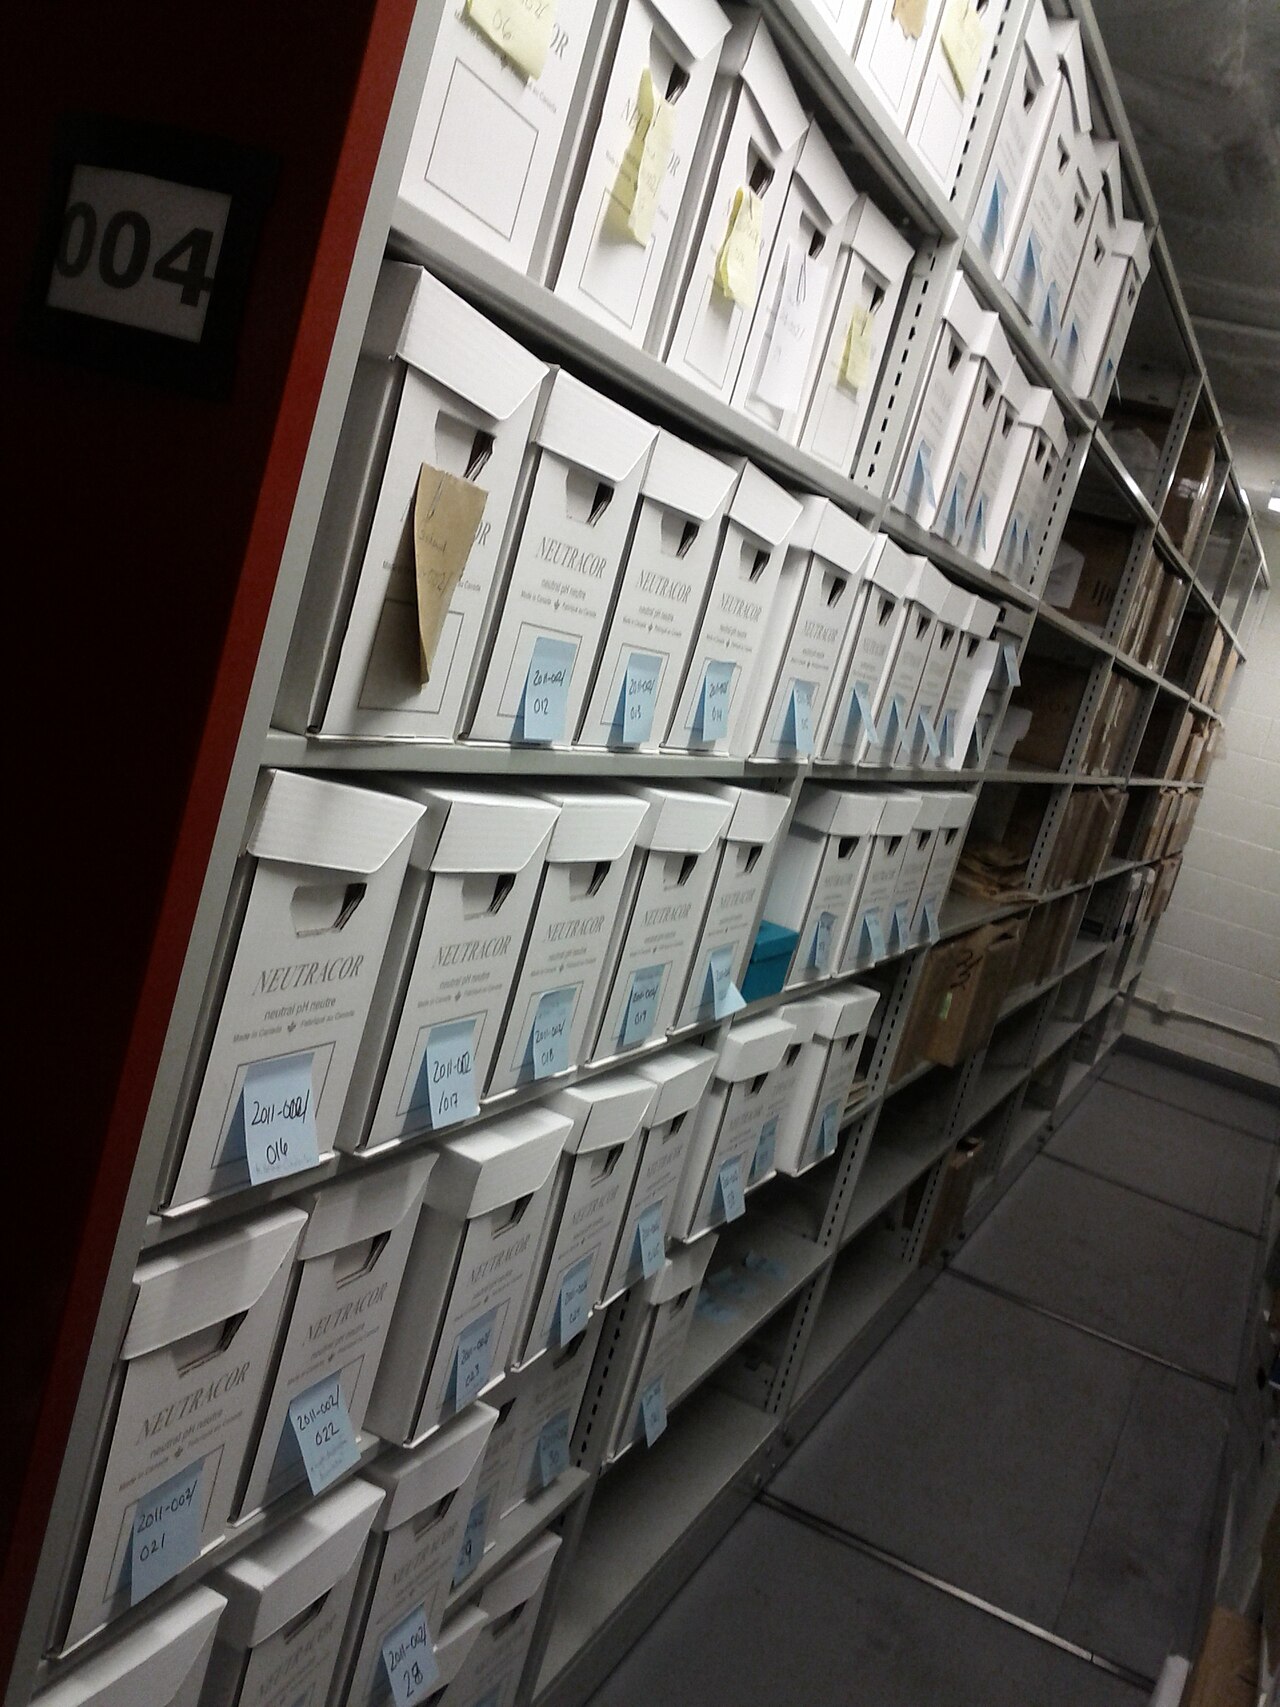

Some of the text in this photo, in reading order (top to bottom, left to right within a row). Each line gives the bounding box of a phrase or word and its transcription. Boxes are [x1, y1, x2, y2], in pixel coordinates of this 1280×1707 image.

[57, 201, 215, 308] 004
[535, 536, 607, 579] NEUTRACOR
[636, 569, 692, 604] NEUTRACOR
[719, 592, 763, 623] NEUTRACOR
[533, 698, 549, 715] 012
[543, 914, 605, 943] NEUTRACOR
[432, 935, 512, 968] NEUTRACOR
[251, 954, 365, 996] NEUTRACOR
[264, 998, 336, 1021] neutral pH neutre
[233, 1032, 251, 1043] Made
[266, 1137, 288, 1165] 016
[302, 1281, 388, 1346] NEUTRACOR
[135, 1361, 251, 1446] NEUTRACOR
[297, 1384, 340, 1431] 2011-002/
[315, 1422, 340, 1446] 022
[137, 1479, 198, 1533] 2011-002/
[139, 1533, 166, 1562] 021
[403, 1661, 424, 1698] 28
